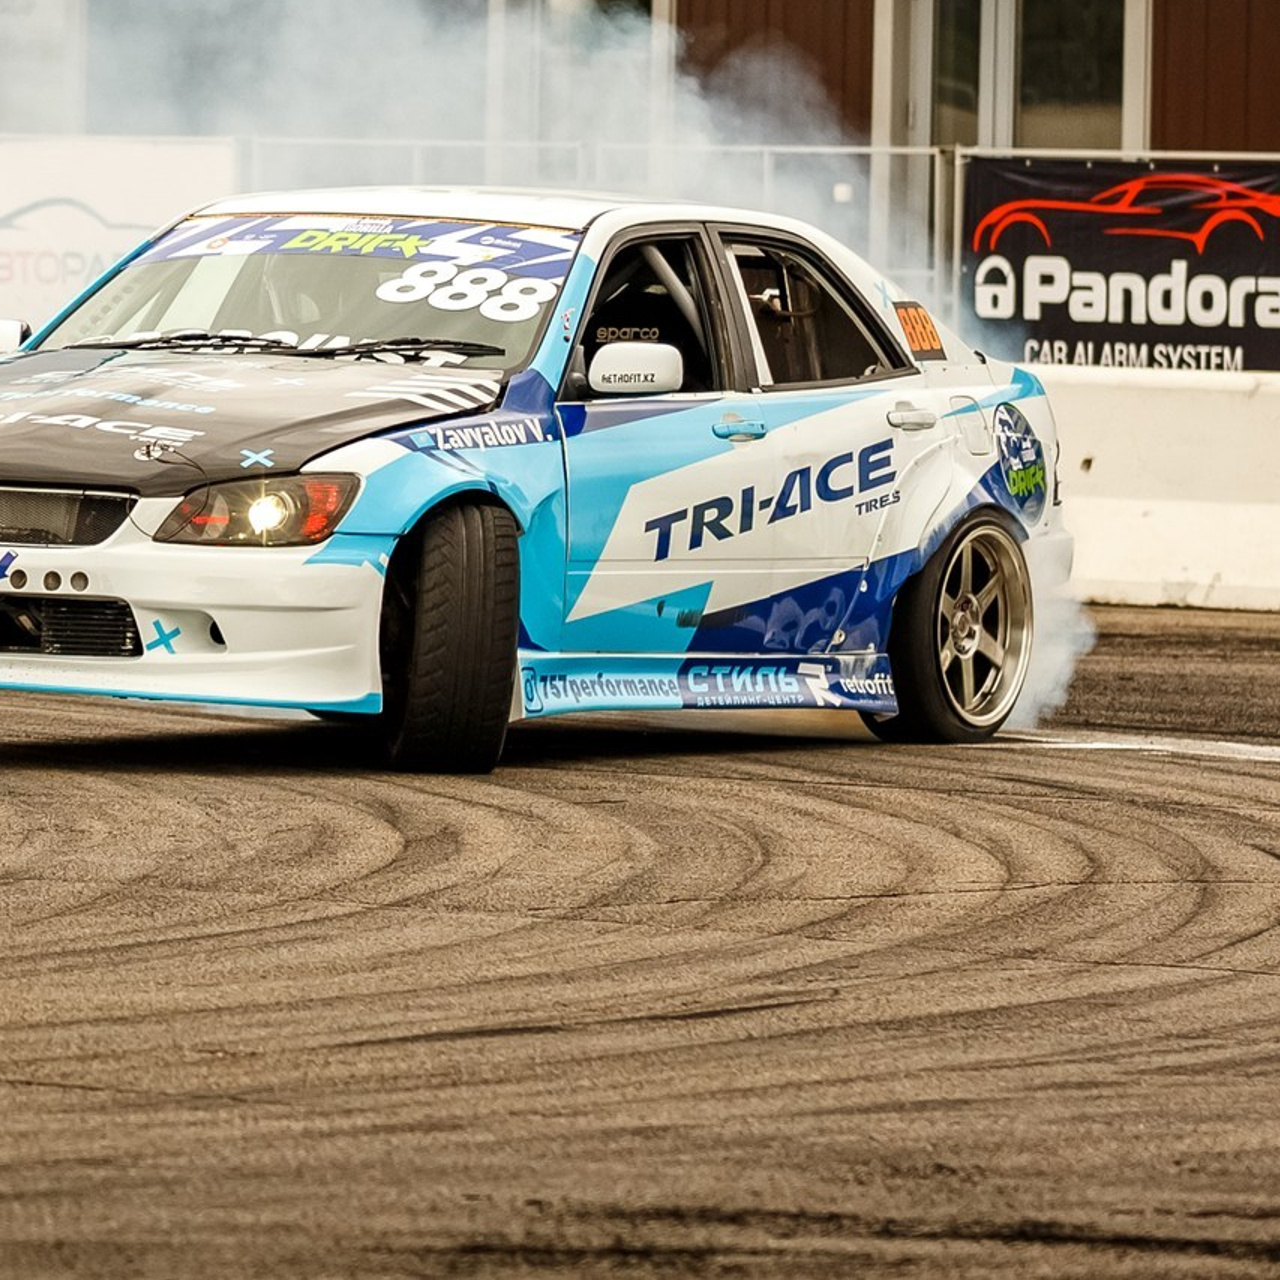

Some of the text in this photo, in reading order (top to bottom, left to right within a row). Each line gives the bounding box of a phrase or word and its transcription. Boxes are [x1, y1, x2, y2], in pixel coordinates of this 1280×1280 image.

[279, 229, 433, 259] DRIFT
[375, 261, 558, 322] 888
[1023, 254, 1280, 328] Pandora
[596, 327, 660, 341] sparco
[896, 307, 942, 352] 888
[1024, 339, 1244, 370] CAR ALARM SYSTEM
[431, 418, 554, 452] Zavyalov V.
[644, 437, 898, 562] TRI-ACE
[855, 490, 901, 516] TIRES
[540, 671, 680, 703] 757performance
[687, 665, 800, 693] СТИЛЬ
[839, 672, 895, 695] retrofit
